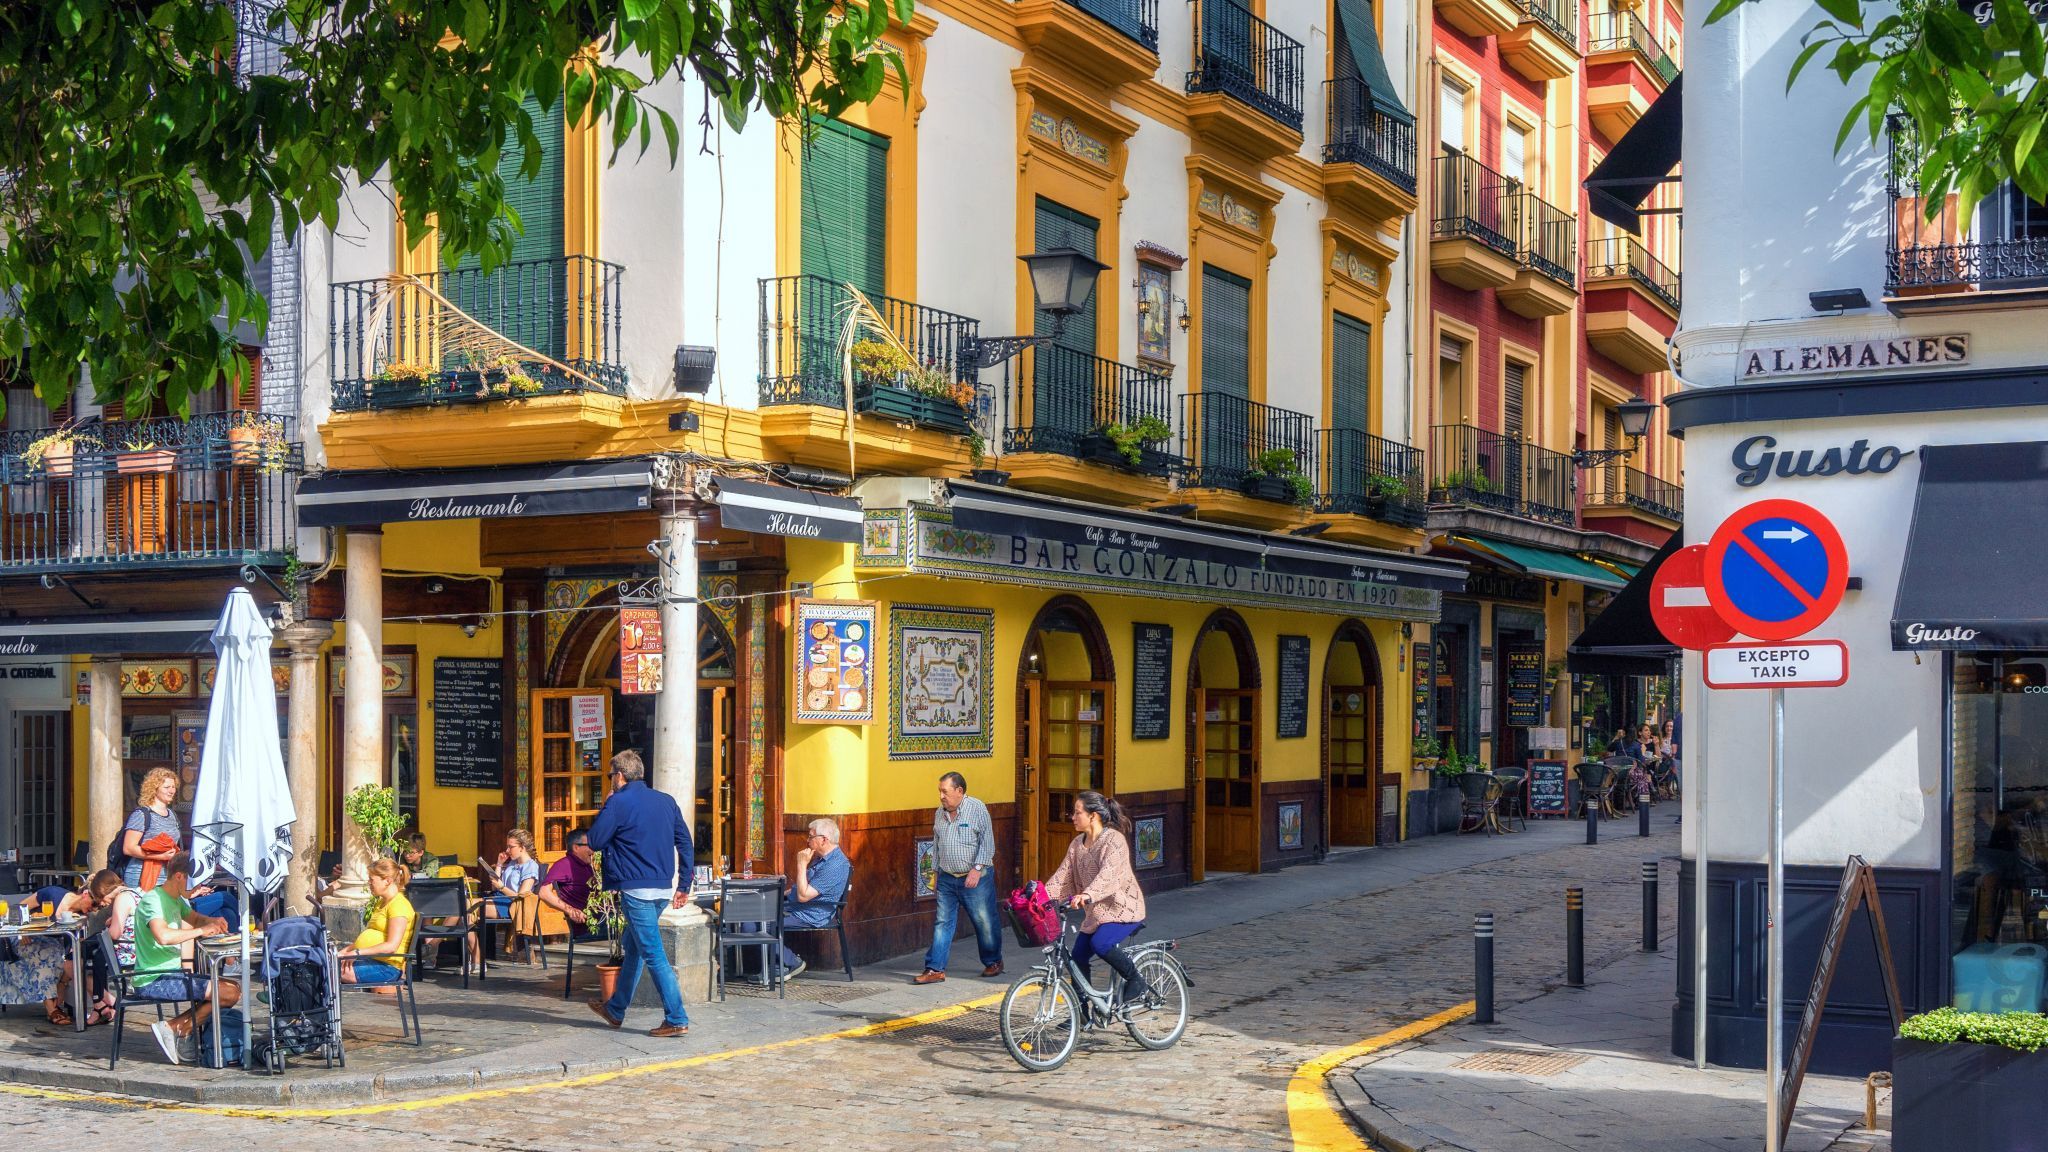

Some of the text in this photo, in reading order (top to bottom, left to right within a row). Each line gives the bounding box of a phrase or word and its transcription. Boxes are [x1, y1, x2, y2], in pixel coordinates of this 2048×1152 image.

[1745, 336, 1966, 376] ALEMANES
[1732, 435, 1915, 487] Gusto
[408, 494, 526, 519] Restaurante
[766, 513, 822, 537] Helados
[1109, 529, 1126, 545] Bar
[1130, 533, 1161, 553] Gonzalo
[1010, 536, 1397, 605] BAR GONZALO FUNDADO EN 1920
[624, 611, 658, 620] GAZPACHO
[1906, 622, 1981, 645] Gusto
[1738, 649, 1810, 662] EXCEPTO
[1751, 666, 1797, 678] TAXIS
